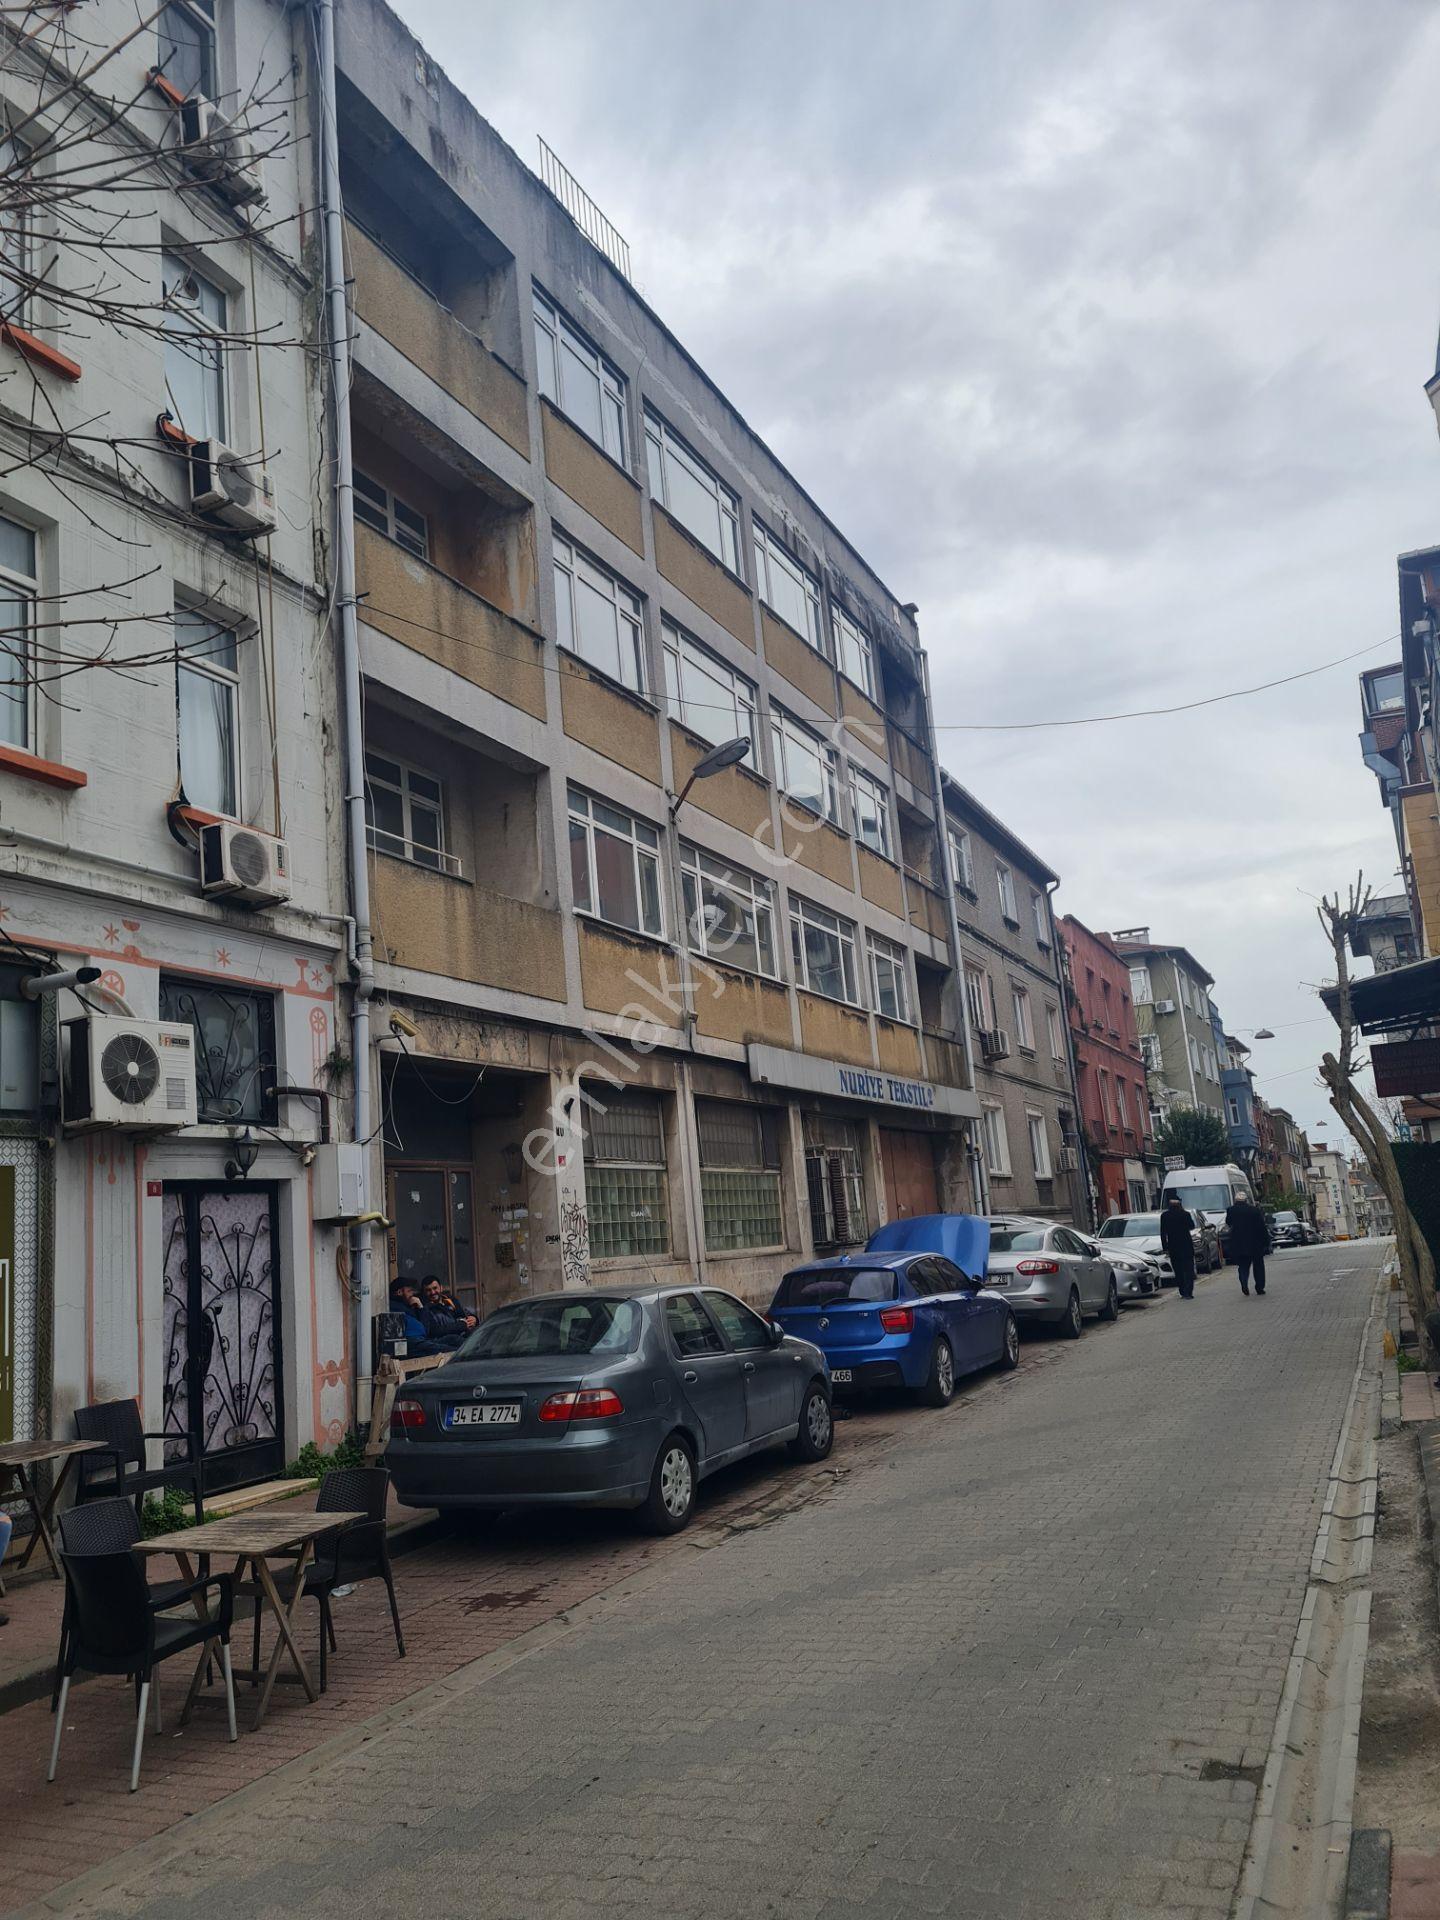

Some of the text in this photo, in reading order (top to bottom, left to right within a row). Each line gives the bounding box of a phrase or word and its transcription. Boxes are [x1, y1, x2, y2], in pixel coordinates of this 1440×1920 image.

[839, 1069, 884, 1099] NURİYE
[886, 1079, 928, 1107] TEKSTİL
[834, 1371, 851, 1381] 466
[454, 1409, 466, 1423] 34
[471, 1408, 484, 1422] EA
[490, 1406, 517, 1422] 2774
